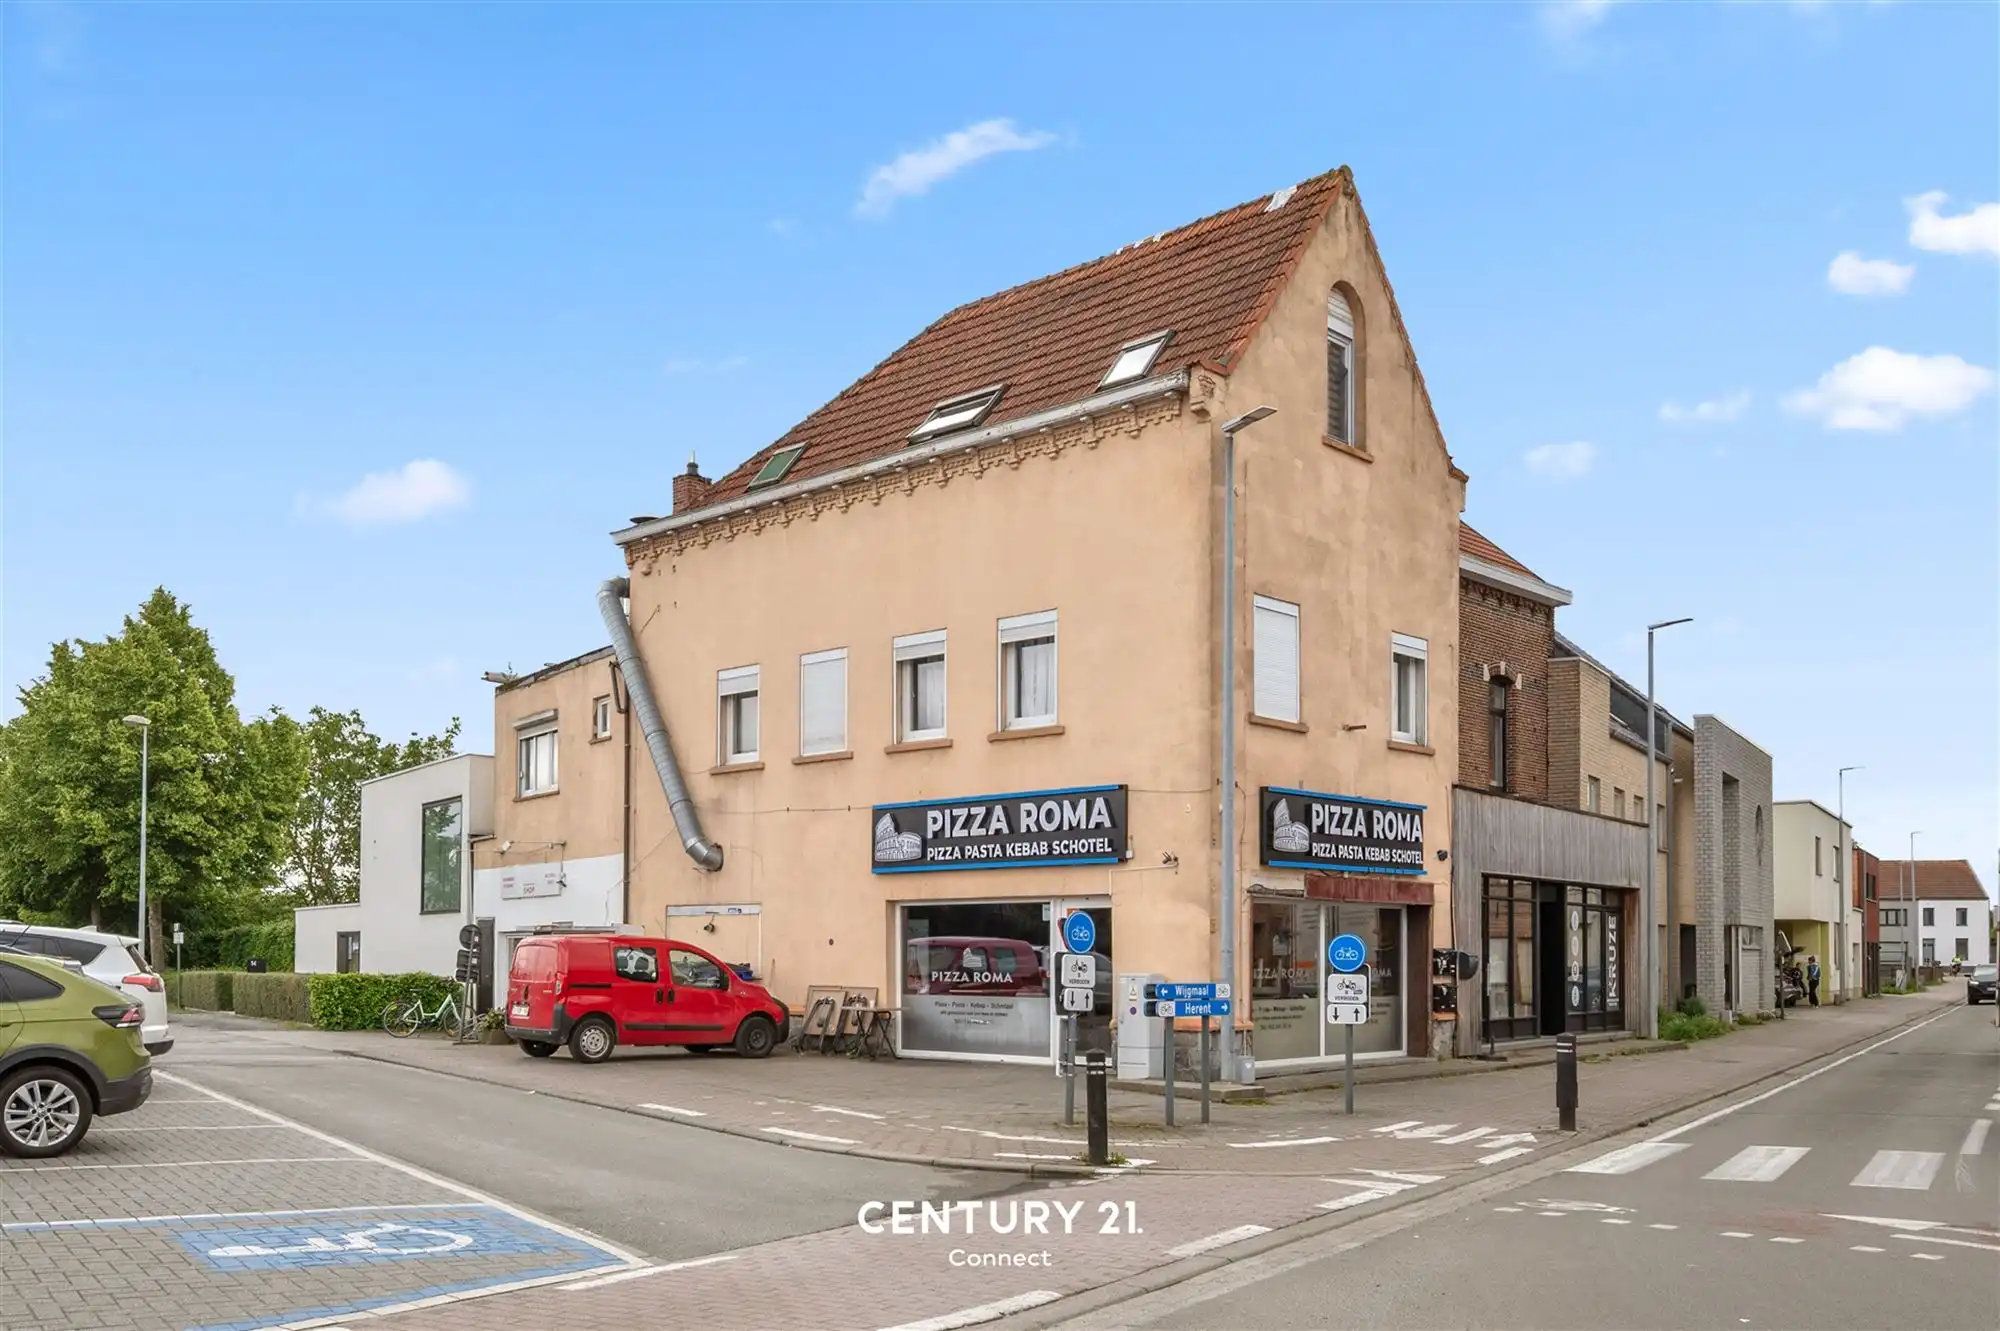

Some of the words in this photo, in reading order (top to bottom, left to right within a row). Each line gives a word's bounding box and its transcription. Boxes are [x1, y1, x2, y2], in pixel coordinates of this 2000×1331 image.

[927, 805, 1010, 839] PIZZA
[1020, 796, 1112, 833] ROMA
[1312, 803, 1368, 838] PIZZA
[1372, 810, 1423, 842] ROMA
[927, 846, 962, 861] PIZZA
[965, 843, 1002, 859] PASTA
[1006, 841, 1048, 856] KEBAB
[1052, 838, 1112, 855] SCHOTEL
[1312, 843, 1337, 858] PIZZA
[1338, 845, 1363, 860] PASTA
[1365, 847, 1391, 861] KEBAB
[1392, 848, 1423, 864] SCHOTEL
[1608, 915, 1617, 997] KRUZE
[931, 971, 970, 982] PIZZA
[973, 972, 1013, 983] ROMA
[1253, 968, 1278, 979] IZZA
[1371, 968, 1392, 977] OMA
[1175, 984, 1209, 998] Wijgmaal
[1185, 1002, 1211, 1014] Herent
